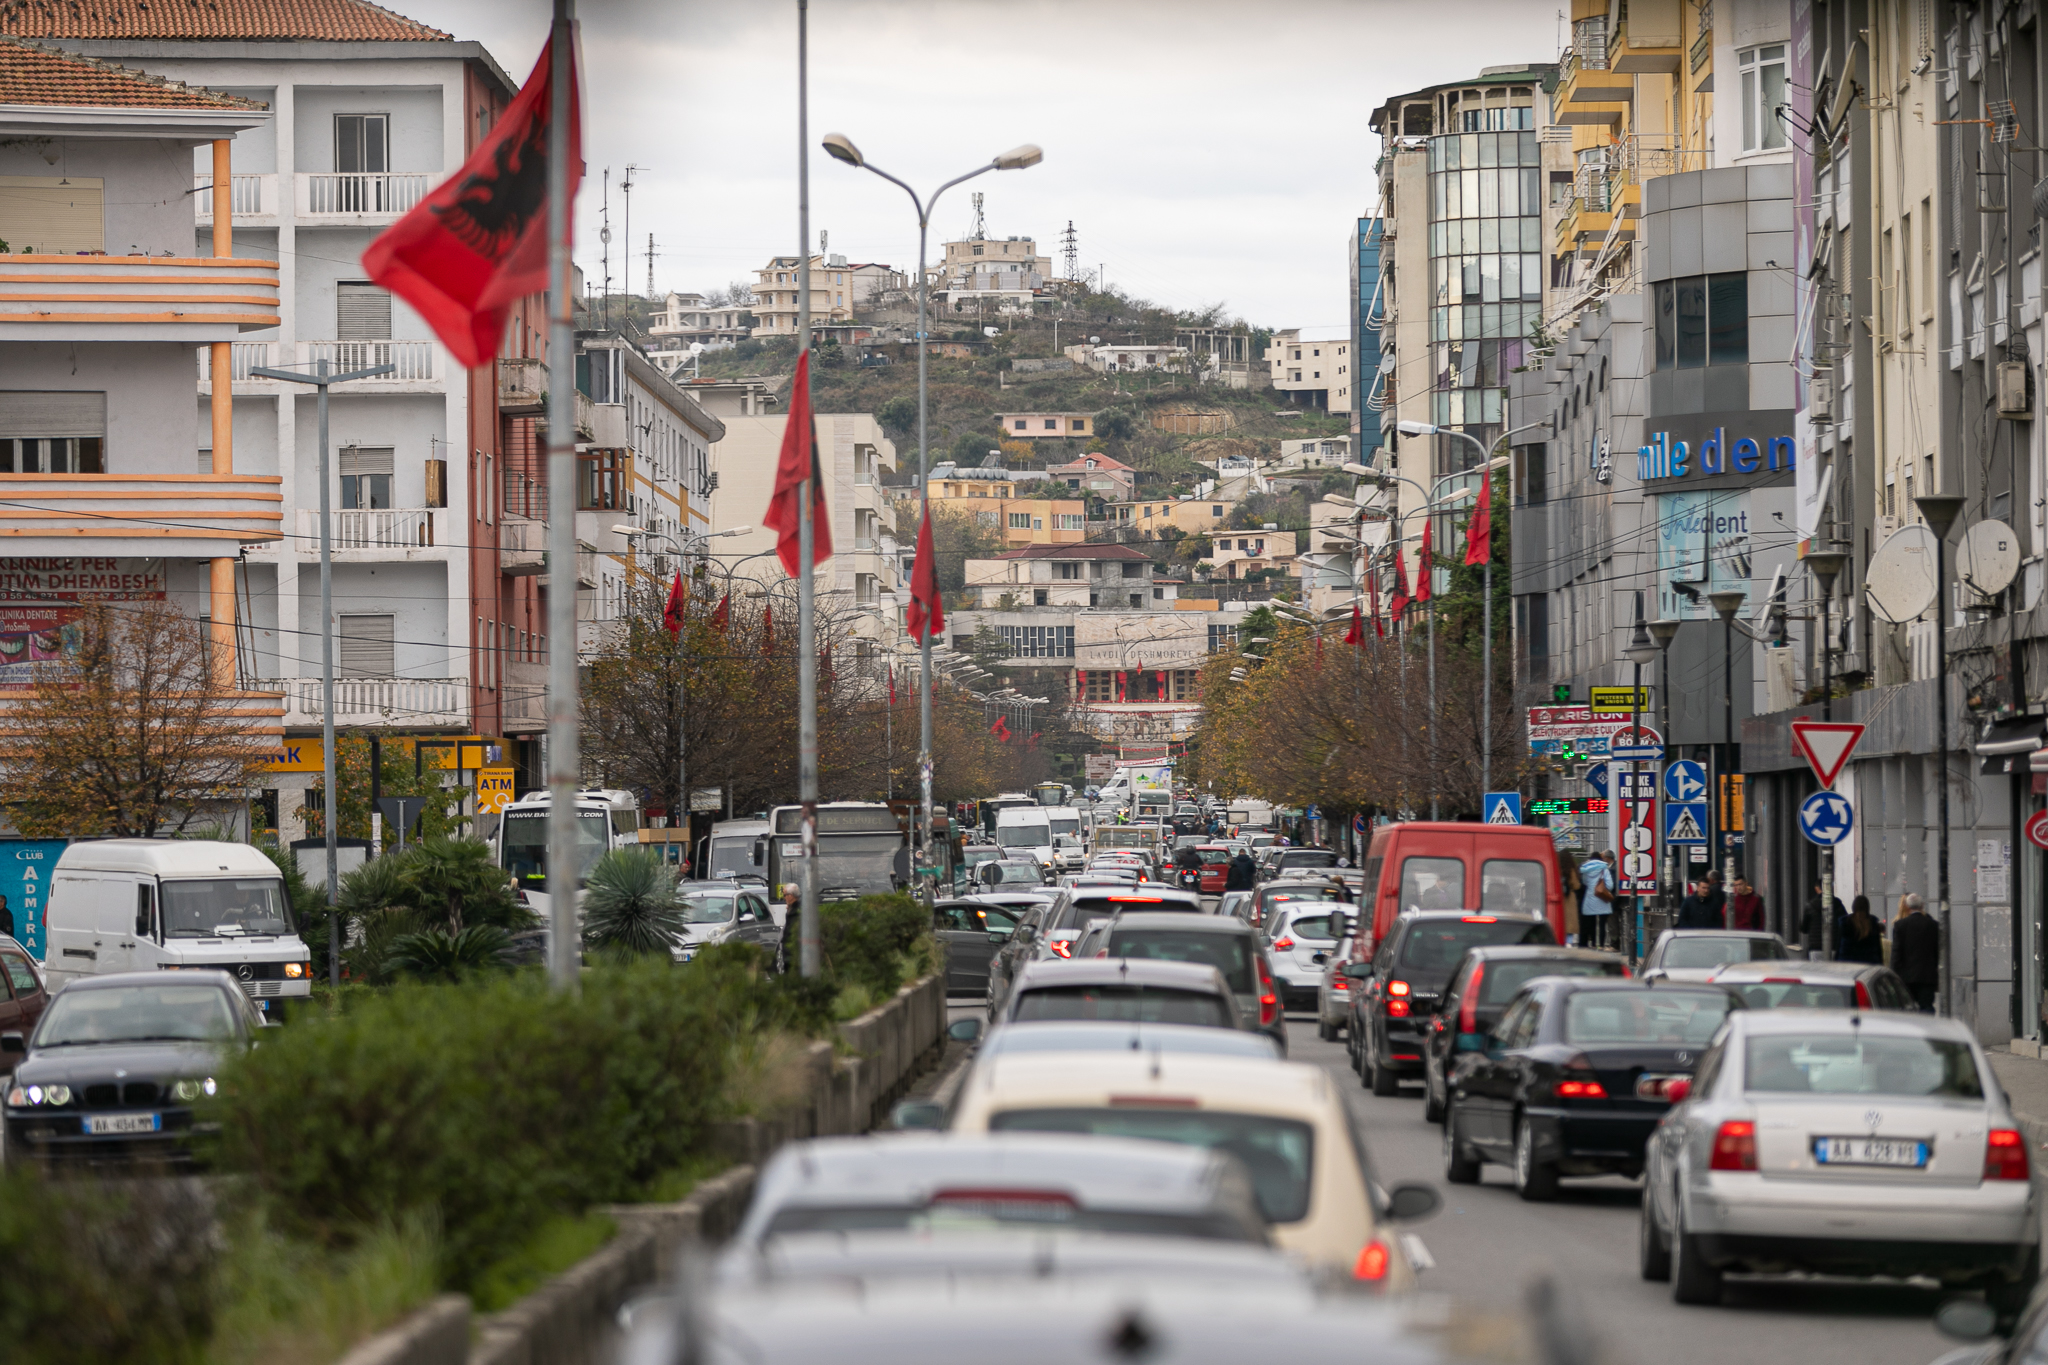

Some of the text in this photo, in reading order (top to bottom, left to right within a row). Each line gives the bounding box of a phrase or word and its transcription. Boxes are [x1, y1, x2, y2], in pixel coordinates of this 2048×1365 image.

[49, 574, 158, 590] DHEMBESH
[26, 610, 58, 620] DENTARE
[1089, 651, 1193, 659] LAVDI DESHMOREVE
[1554, 709, 1624, 721] ARISTON
[481, 778, 512, 790] ATM
[1625, 775, 1649, 786] DKE
[16, 849, 44, 860] CLUB
[1621, 880, 1655, 890] LKE
[22, 866, 39, 948] ADMIRA
